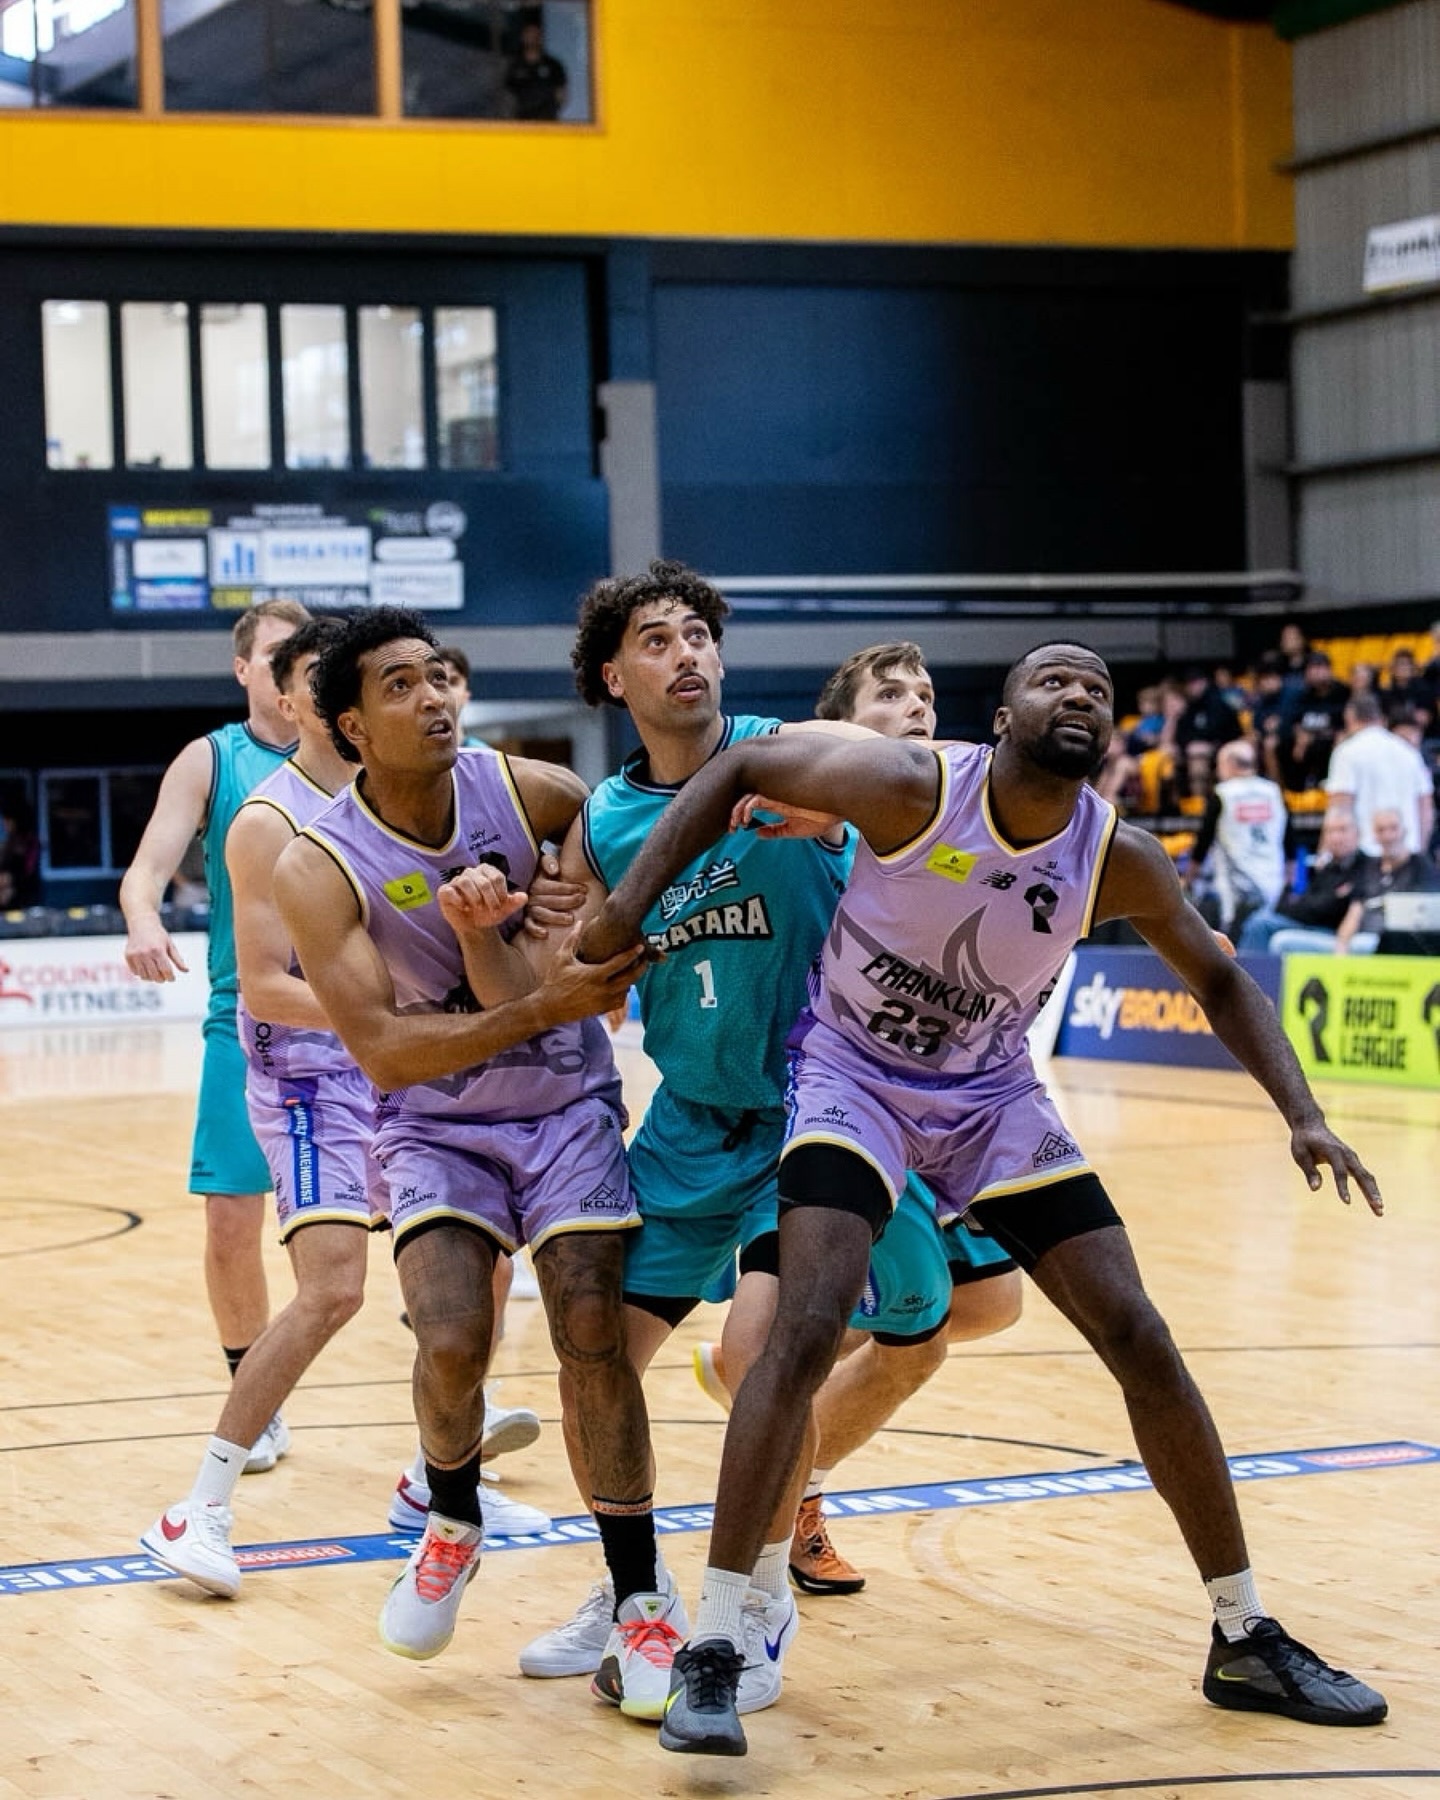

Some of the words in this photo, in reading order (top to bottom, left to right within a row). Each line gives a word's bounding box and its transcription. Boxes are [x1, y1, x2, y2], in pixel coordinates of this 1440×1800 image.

[41, 988, 162, 1013] FITNESS
[693, 959, 718, 1009] 1
[859, 952, 996, 1023] FRANKLIN
[866, 999, 951, 1057] 23
[1341, 1035, 1406, 1070] LEAGUE
[804, 1116, 862, 1135] BROADBAND
[822, 1104, 850, 1120] sky
